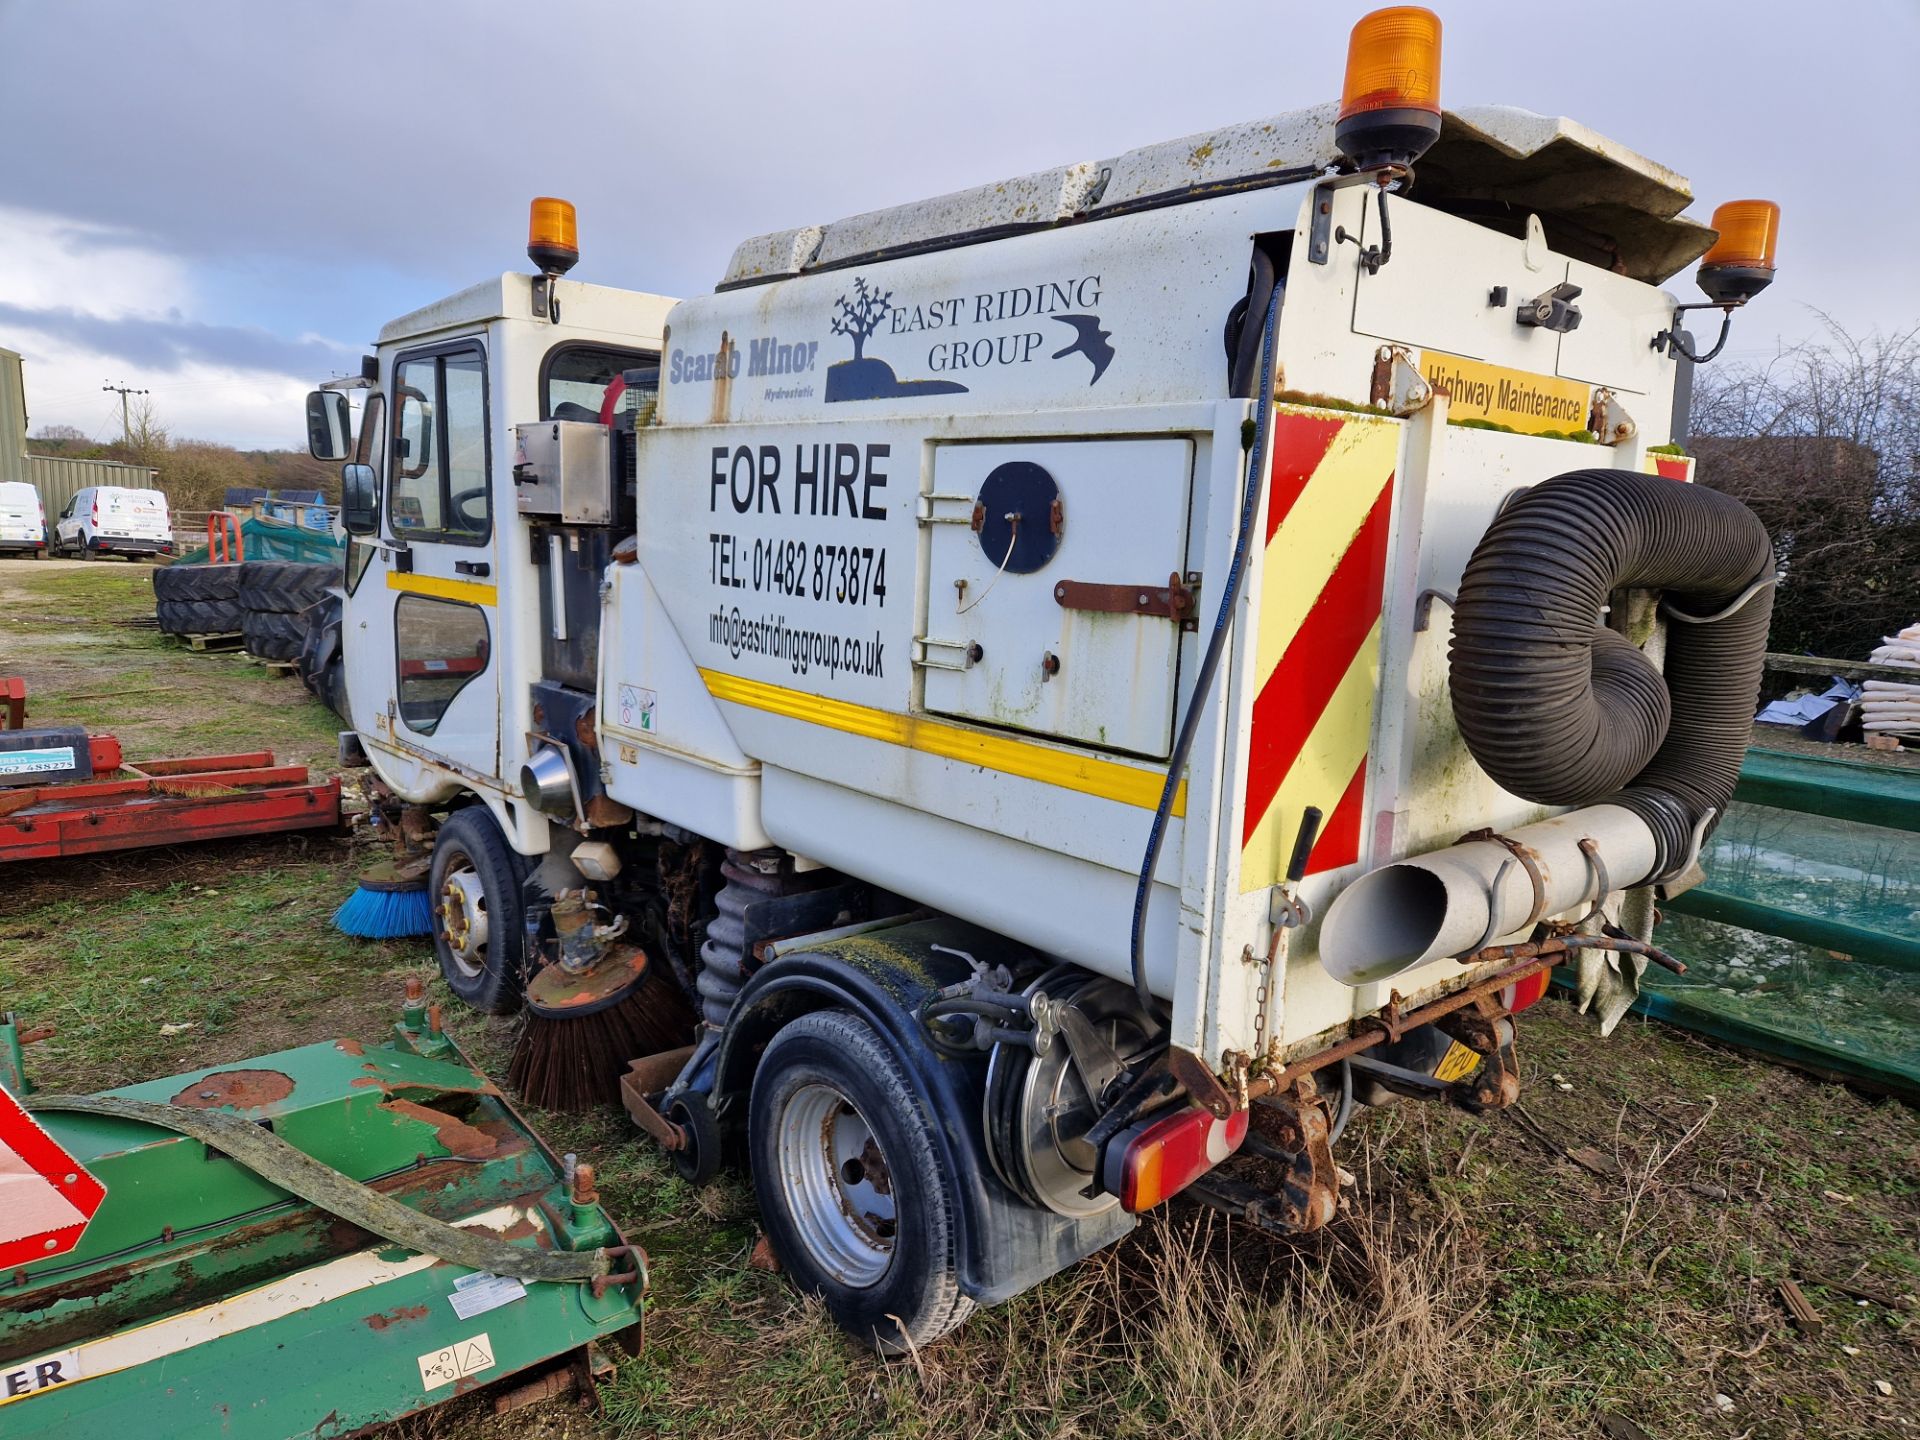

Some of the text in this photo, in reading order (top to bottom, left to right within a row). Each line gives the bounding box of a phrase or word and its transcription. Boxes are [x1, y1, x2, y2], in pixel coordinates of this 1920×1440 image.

[889, 275, 1103, 334] EAST RIDING
[670, 336, 818, 384] Scarab Minor
[928, 332, 1043, 372] GROUP
[764, 385, 814, 403] Hydrostatic
[1428, 364, 1581, 422] Highway Maintenance
[710, 444, 890, 520] FOR HIRE
[710, 534, 886, 608] TEL: 01482 873874
[710, 604, 884, 680] info@eastridinggroup.co.uk
